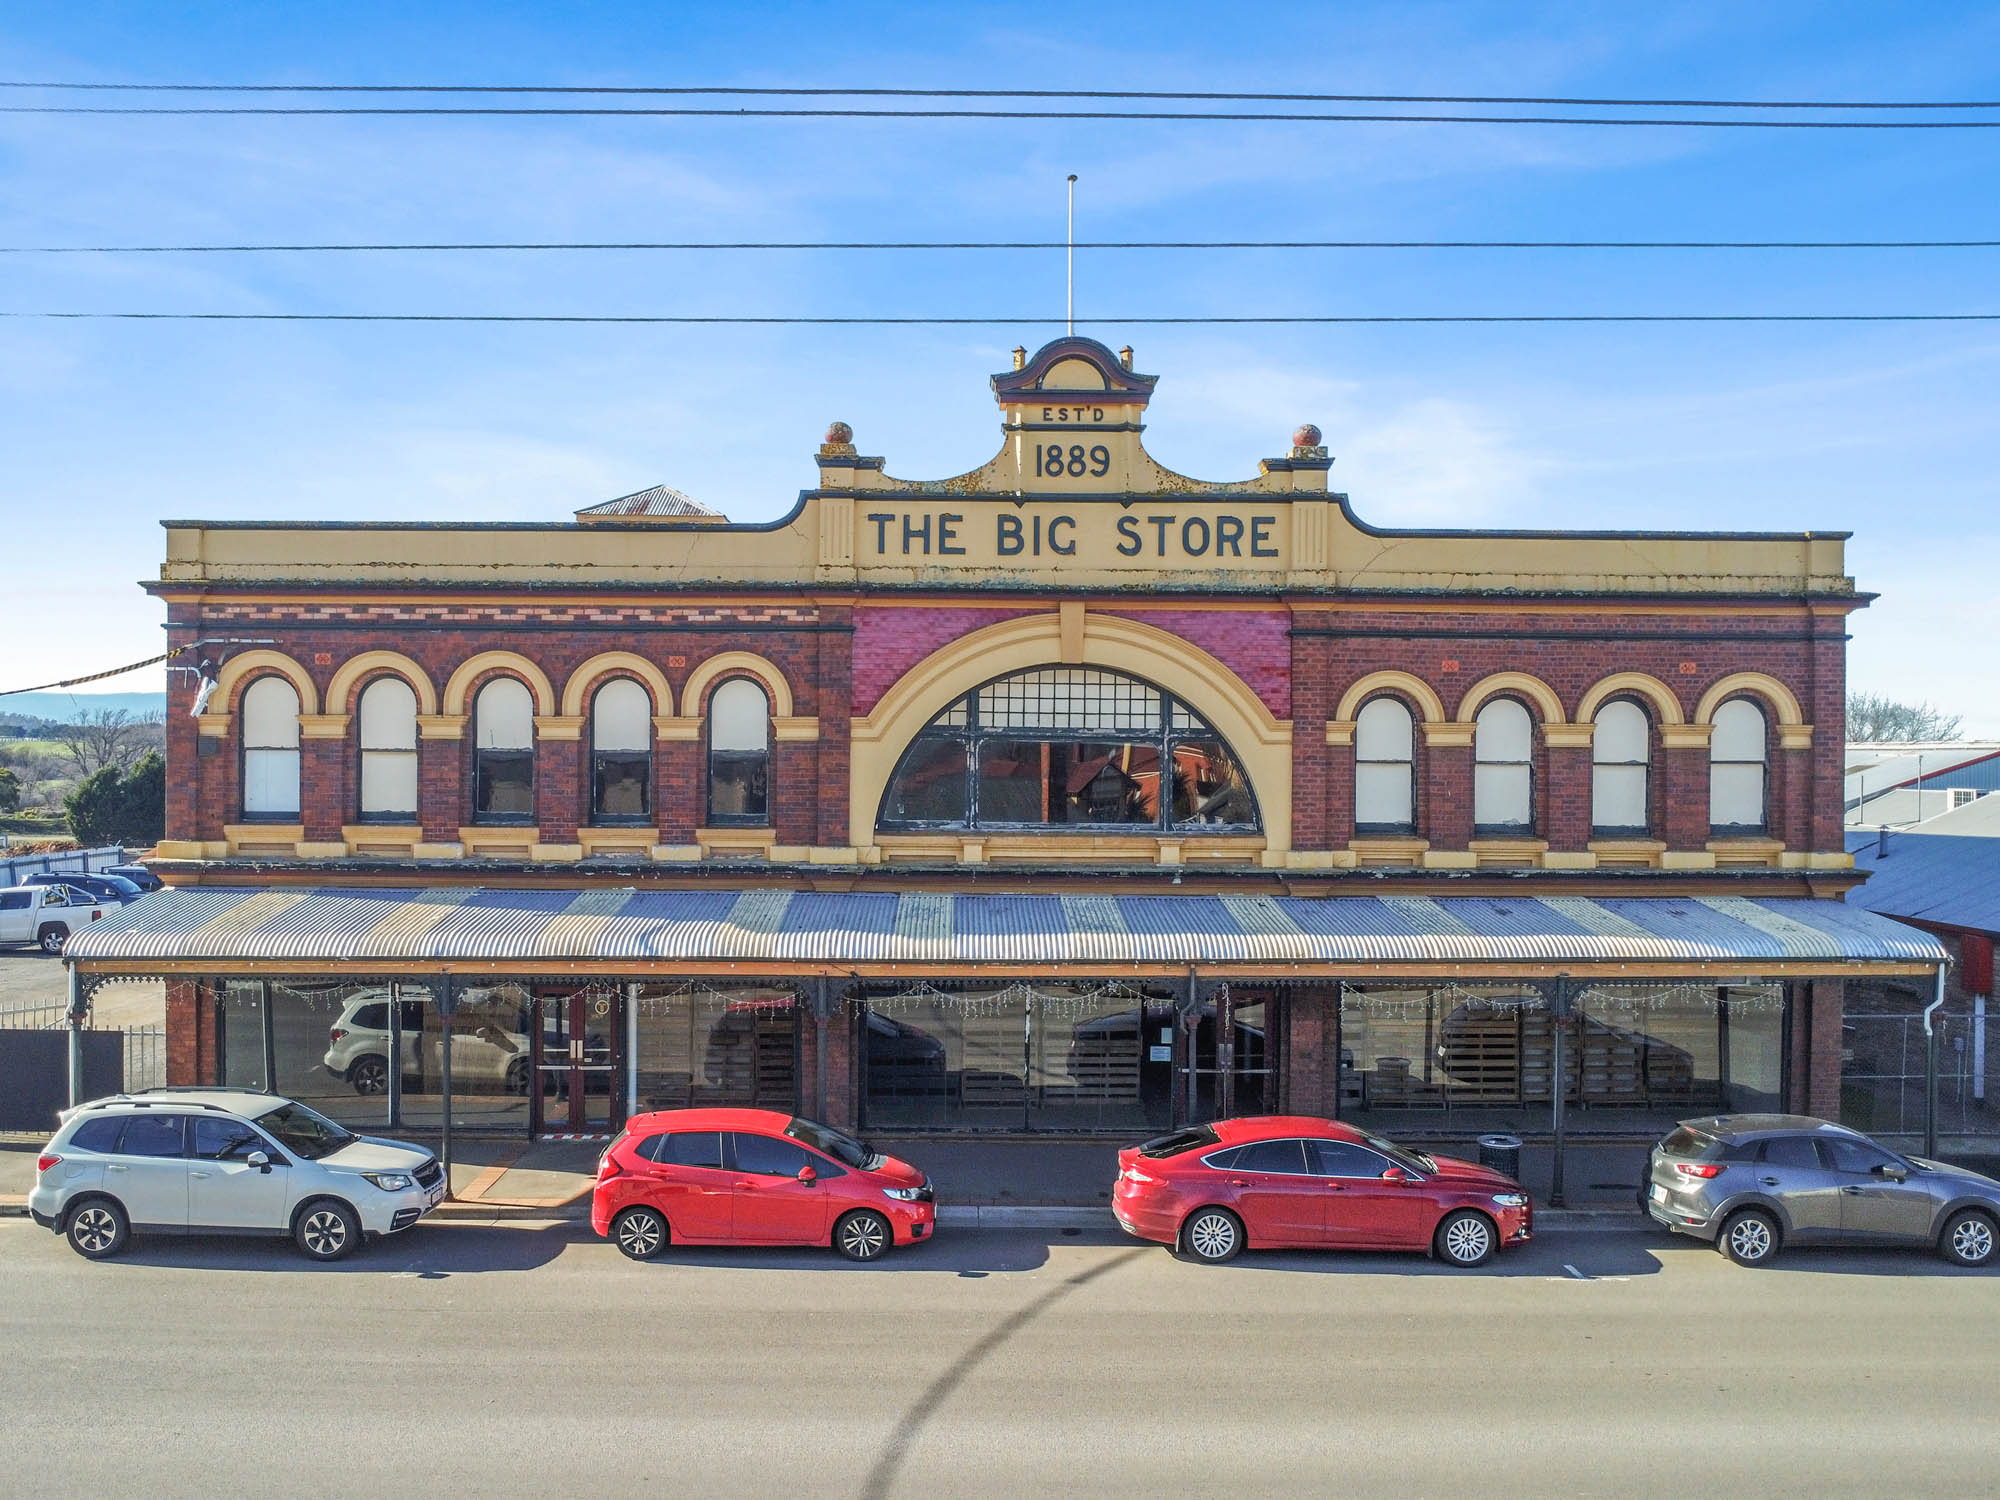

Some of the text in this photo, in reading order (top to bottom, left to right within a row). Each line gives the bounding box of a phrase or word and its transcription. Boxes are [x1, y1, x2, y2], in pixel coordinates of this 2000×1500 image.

[1043, 405, 1104, 422] EST'D
[1036, 444, 1110, 477] 1889
[867, 513, 1279, 557] THE BIG STORE
